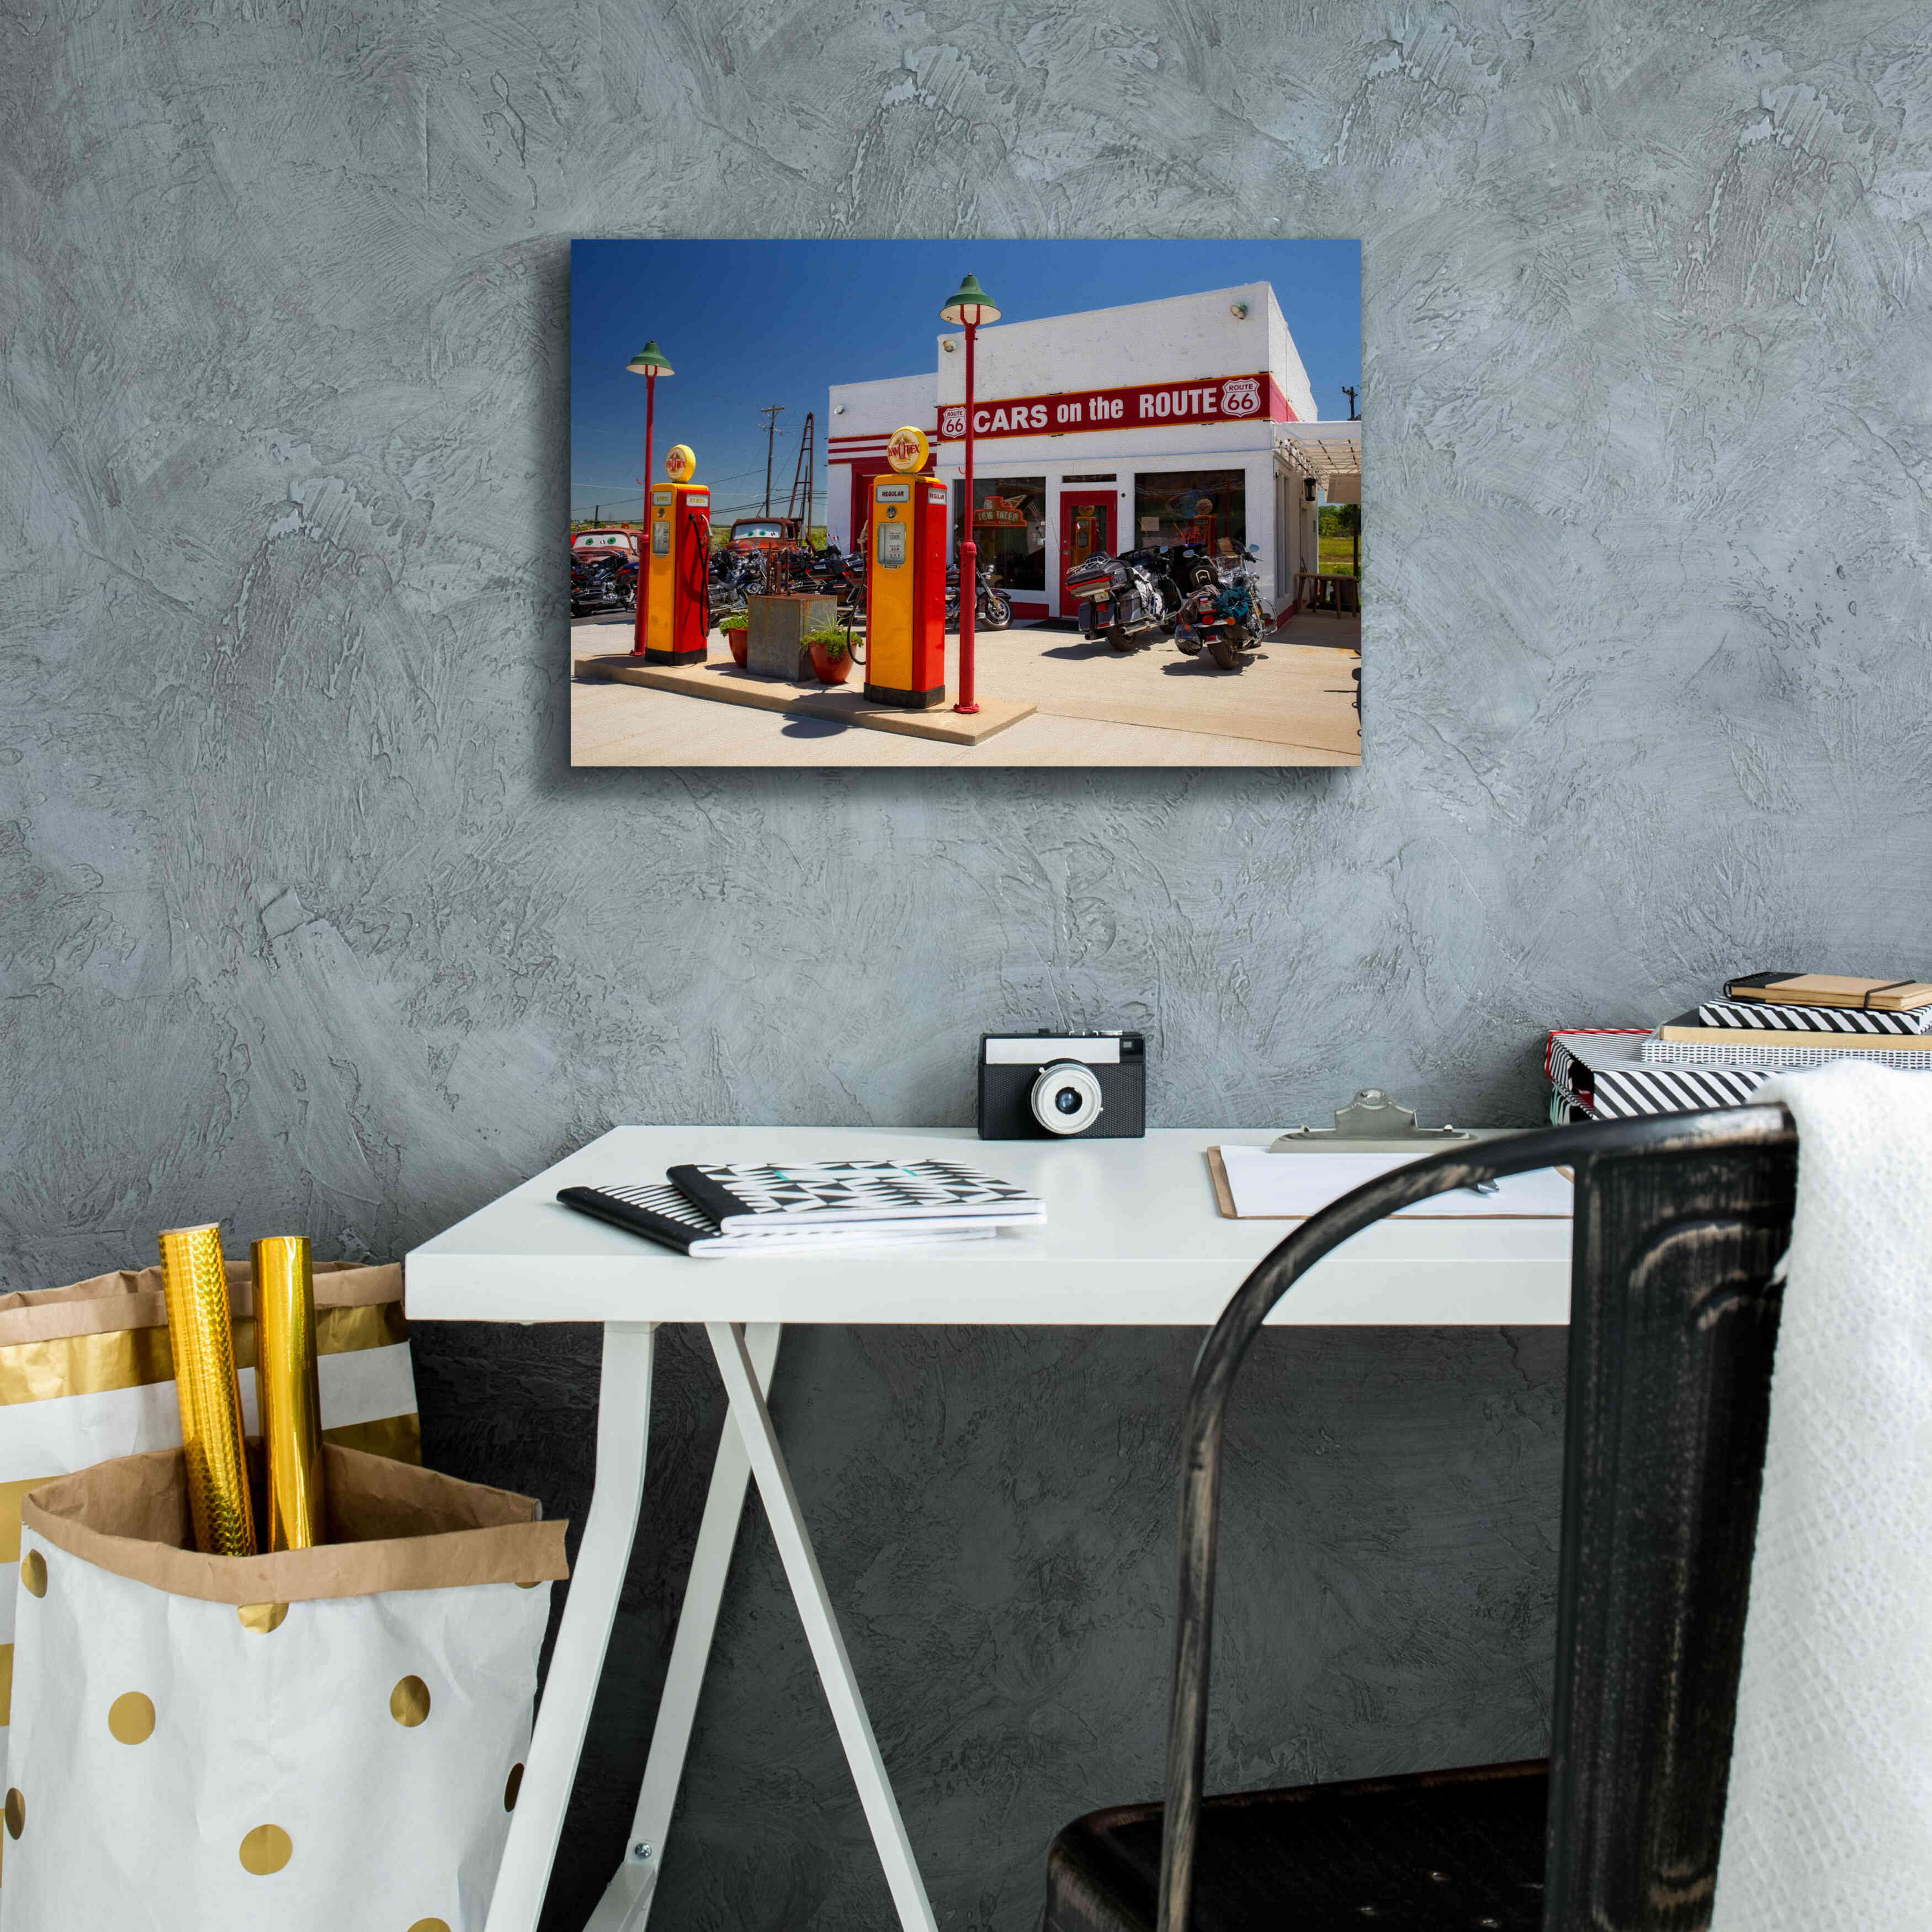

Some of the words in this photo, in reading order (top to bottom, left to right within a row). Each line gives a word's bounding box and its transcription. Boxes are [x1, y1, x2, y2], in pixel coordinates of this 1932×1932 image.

[1228, 392, 1254, 410] 66
[974, 404, 1048, 433] CARS
[1057, 402, 1082, 423] on
[1089, 396, 1123, 421] the
[1139, 388, 1217, 418] ROUTE
[946, 418, 963, 433] 66
